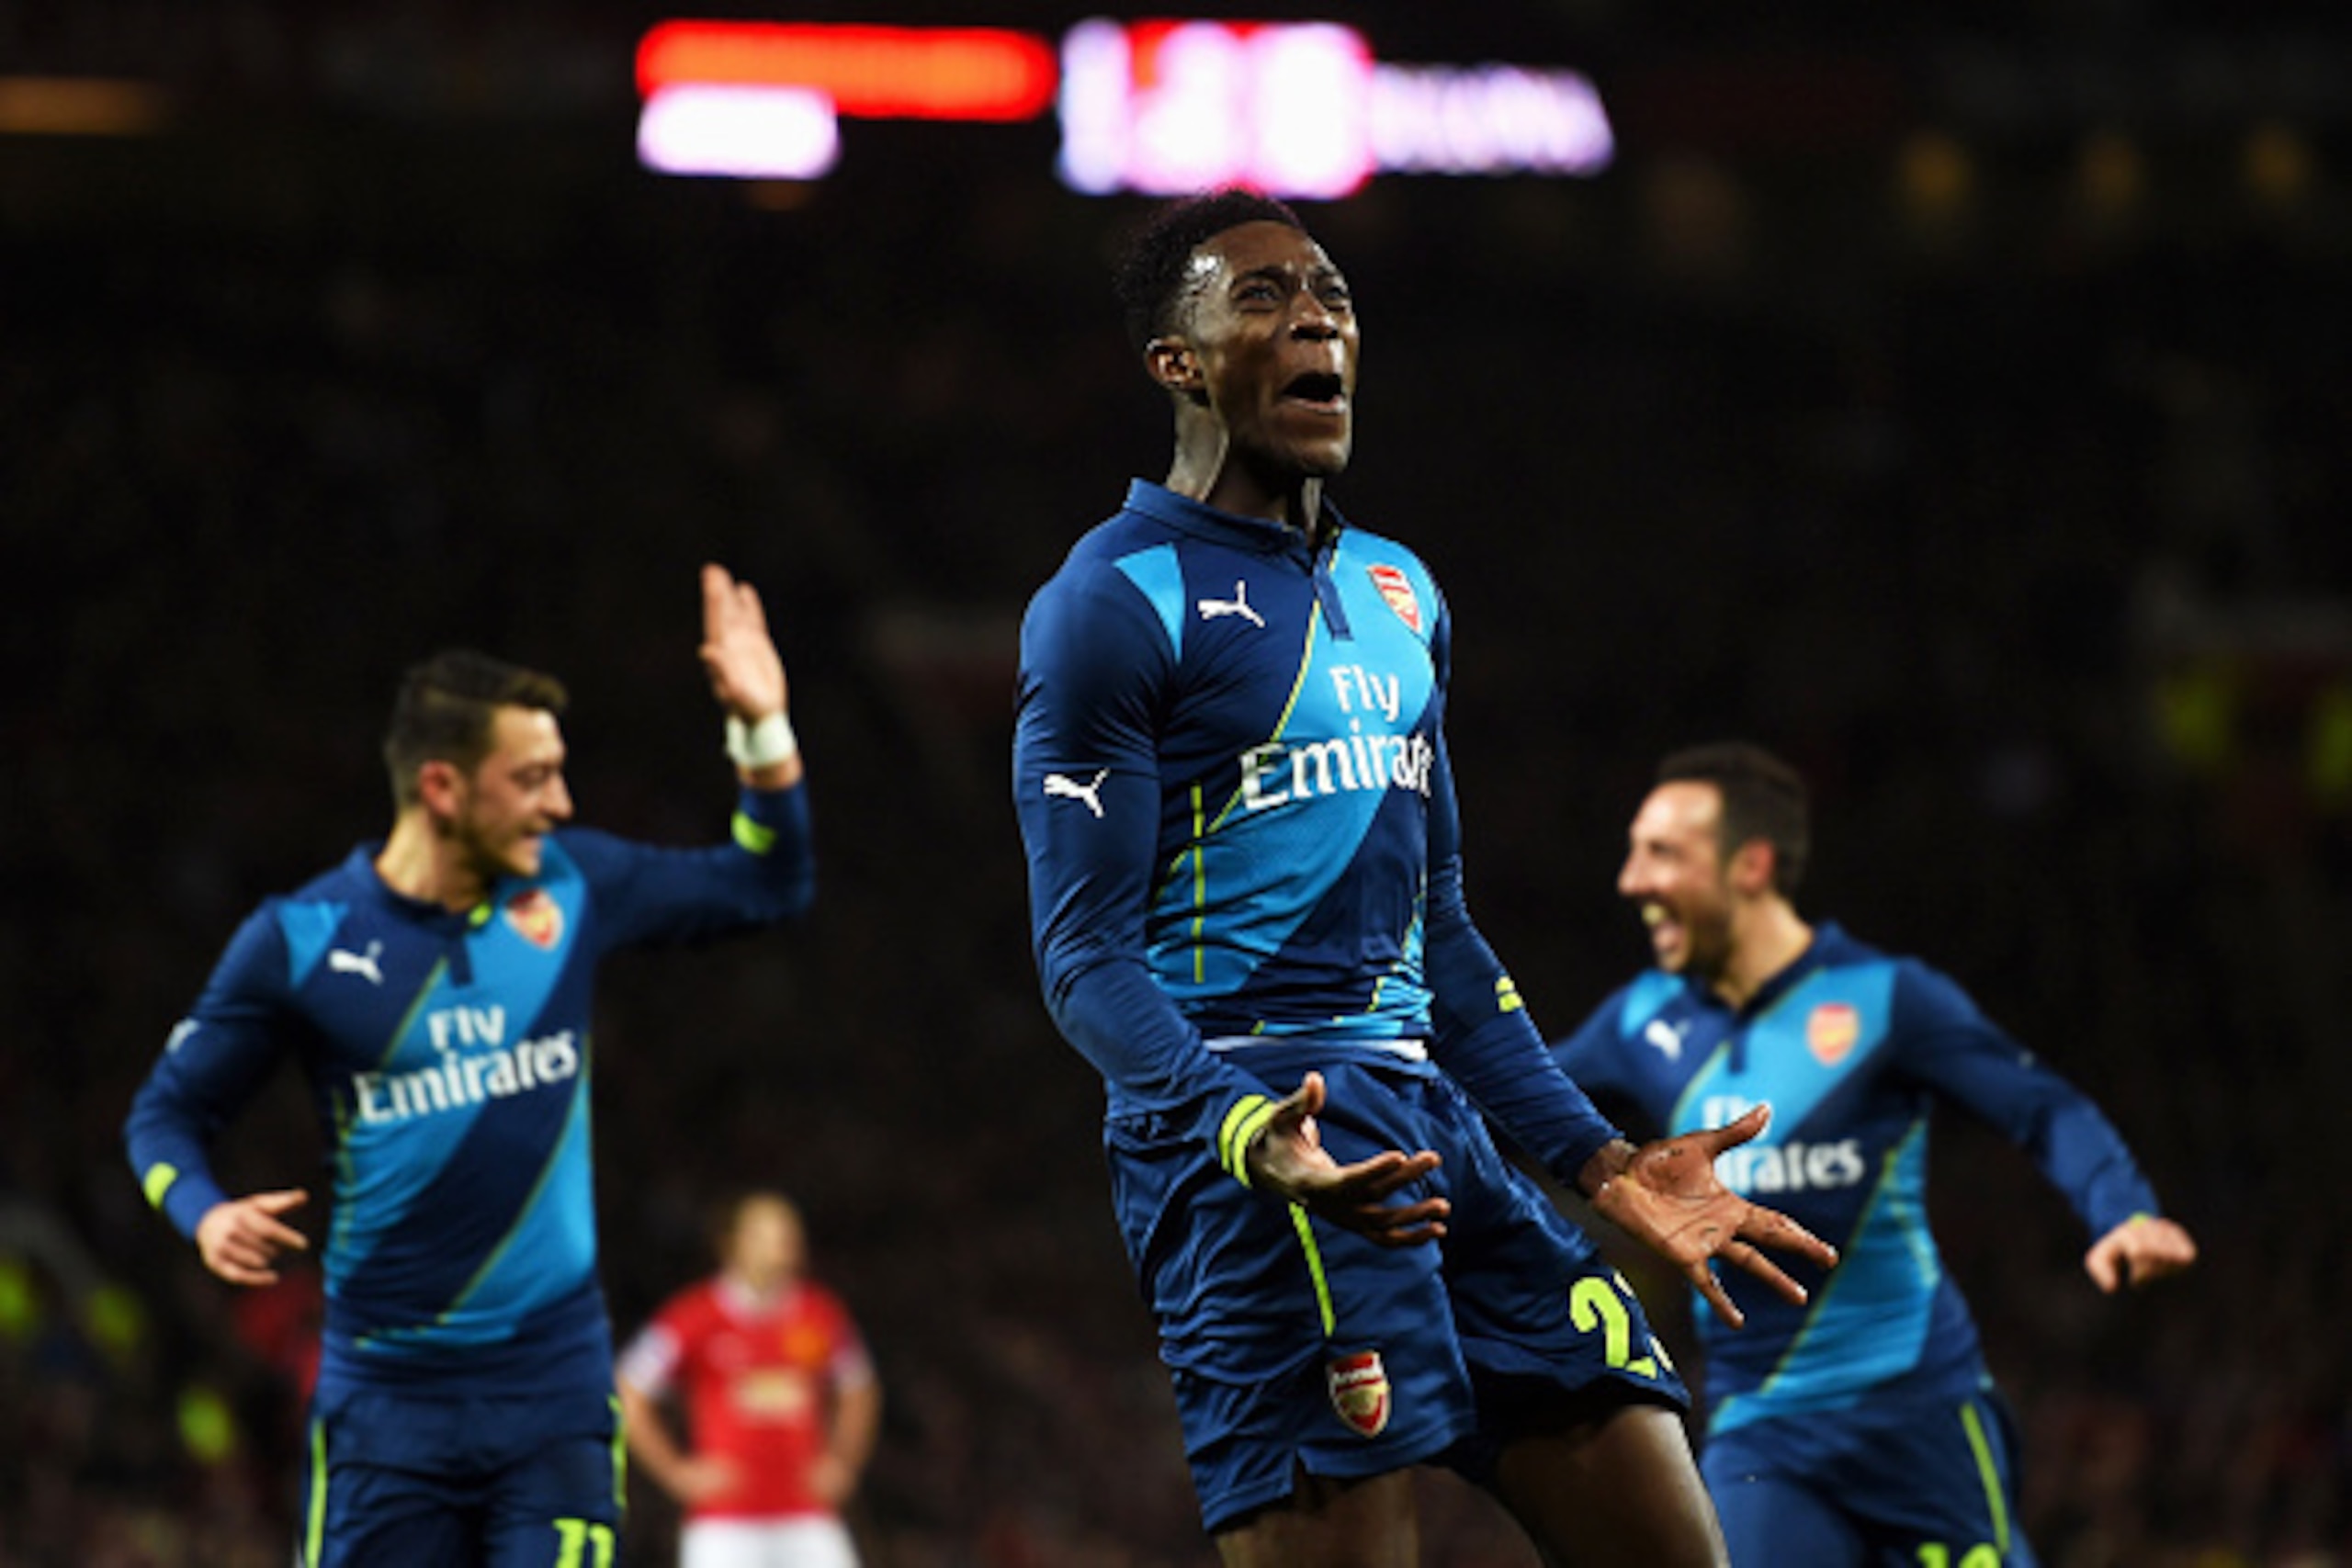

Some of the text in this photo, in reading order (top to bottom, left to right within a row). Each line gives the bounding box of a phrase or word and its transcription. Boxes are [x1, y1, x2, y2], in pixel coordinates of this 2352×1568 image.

[1329, 664, 1399, 722] Fly
[427, 1005, 504, 1053] Fly
[353, 1029, 578, 1123] Emirates
